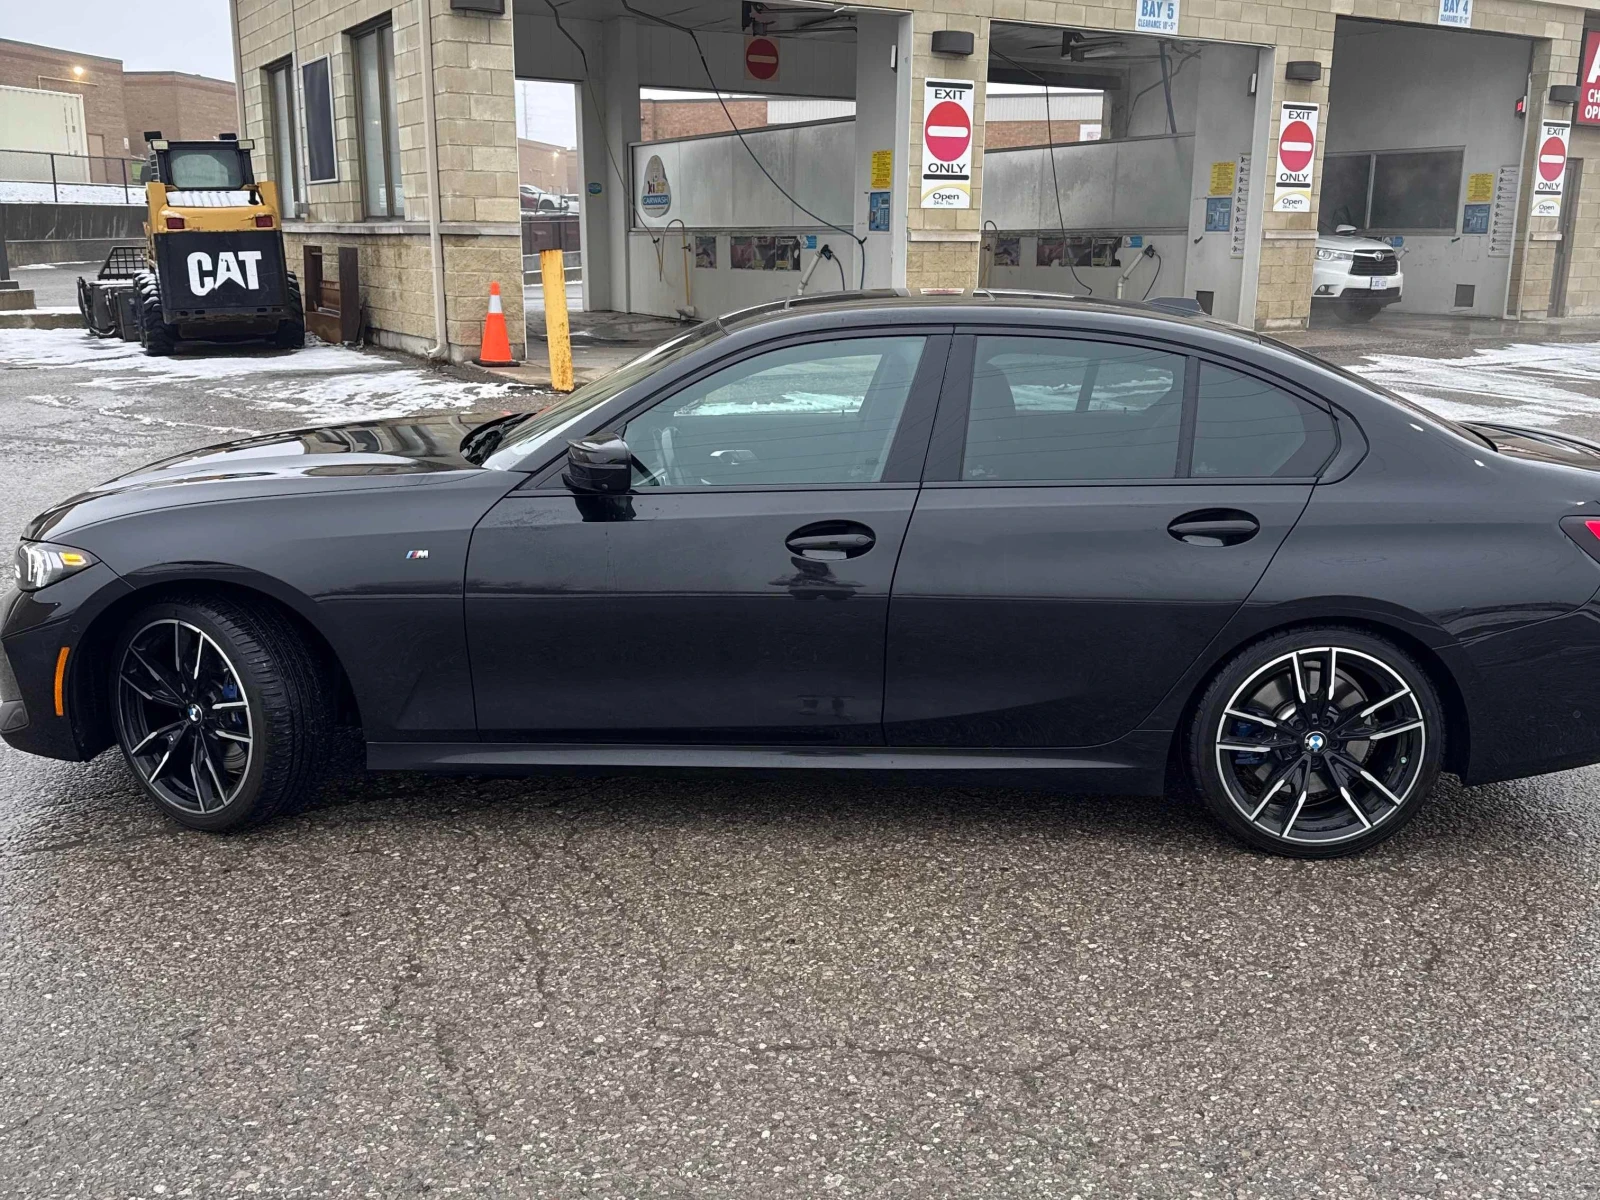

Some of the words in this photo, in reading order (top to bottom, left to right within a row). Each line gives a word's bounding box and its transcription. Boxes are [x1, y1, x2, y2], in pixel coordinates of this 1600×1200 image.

[1141, 0, 1163, 18] BAY
[1167, 3, 1174, 19] 5
[1443, 0, 1460, 13] BAY
[1463, 0, 1469, 15] 4
[1138, 19, 1161, 29] CLEARANCE
[935, 89, 966, 100] EXIT
[1288, 110, 1312, 120] EXIT
[1584, 105, 1600, 119] OP
[1547, 127, 1566, 136] EXIT
[928, 163, 966, 174] ONLY
[1280, 172, 1309, 182] ONLY
[1538, 182, 1561, 190] ONLY
[643, 196, 668, 204] CARWASH
[932, 192, 960, 202] Open
[1282, 198, 1302, 206] Open
[187, 250, 262, 297] CAT
